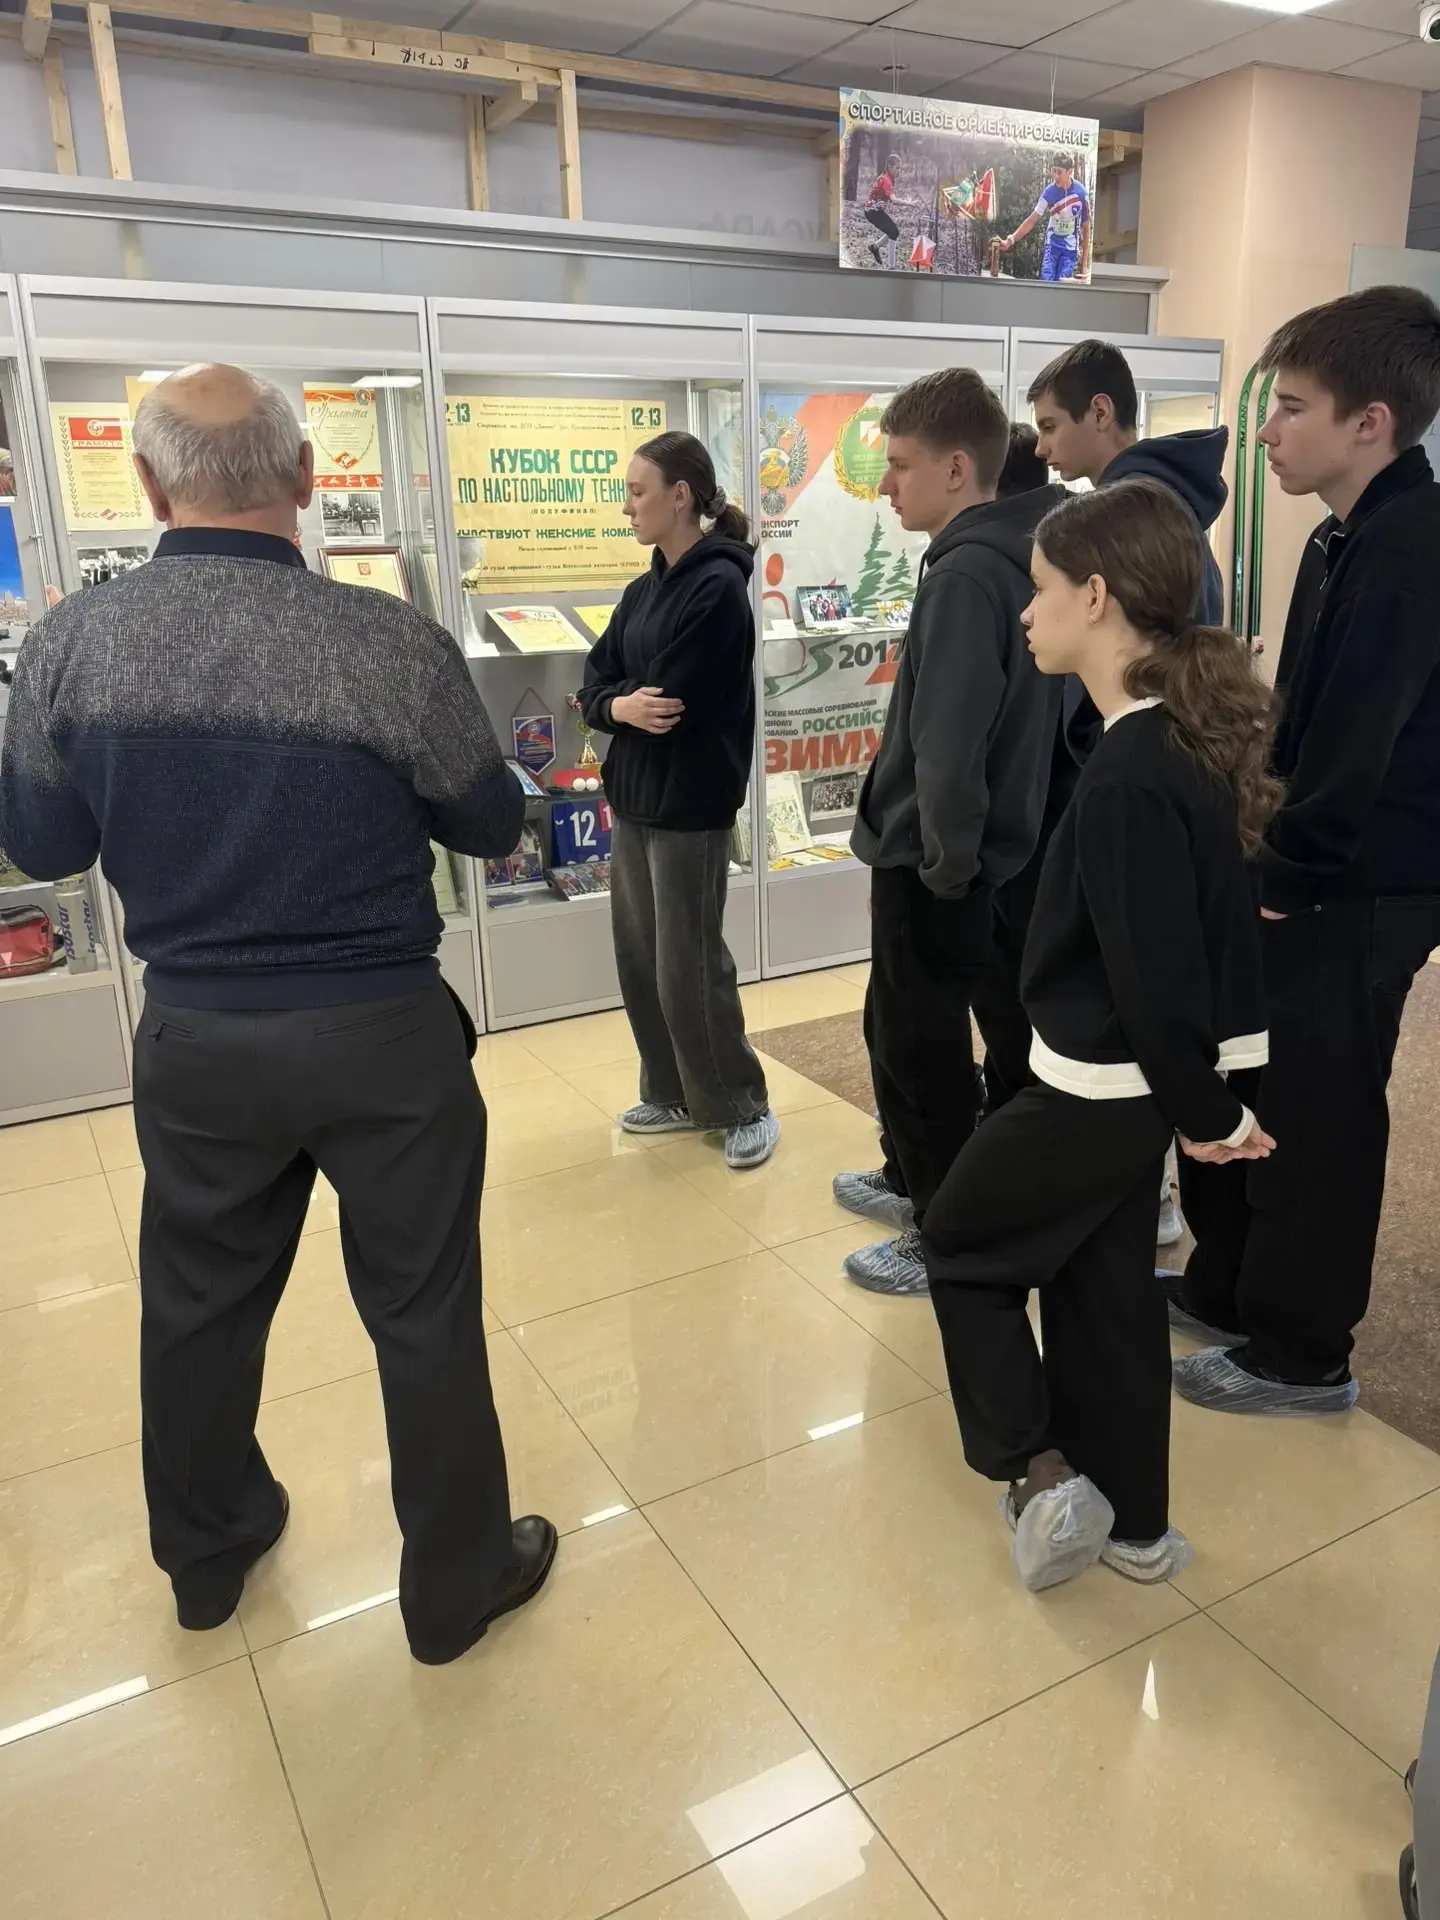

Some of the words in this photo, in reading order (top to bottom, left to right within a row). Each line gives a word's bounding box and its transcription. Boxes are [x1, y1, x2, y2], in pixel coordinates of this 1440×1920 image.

[849, 102, 953, 129] СПОРТИВНОЕ
[956, 115, 1090, 146] ОРИЕНТИРОВАНИЕ
[631, 407, 661, 426] 12-13
[490, 448, 560, 474] КУБОК
[570, 449, 618, 474] СССР
[458, 477, 478, 504] ПО
[483, 477, 585, 504] НАСТОЛЬНОМУ
[591, 478, 627, 503] ТЕНН
[536, 528, 596, 539] ЖЕНСКИЕ
[602, 528, 637, 538] КОМА
[761, 529, 793, 539] ОССИИ
[838, 638, 904, 670] 2017
[788, 706, 823, 716] МАССОВЫЕ
[824, 699, 877, 712] СОРЕВНОВАНИЯ
[765, 727, 881, 774] ЗИМУ
[570, 810, 597, 847] 12
